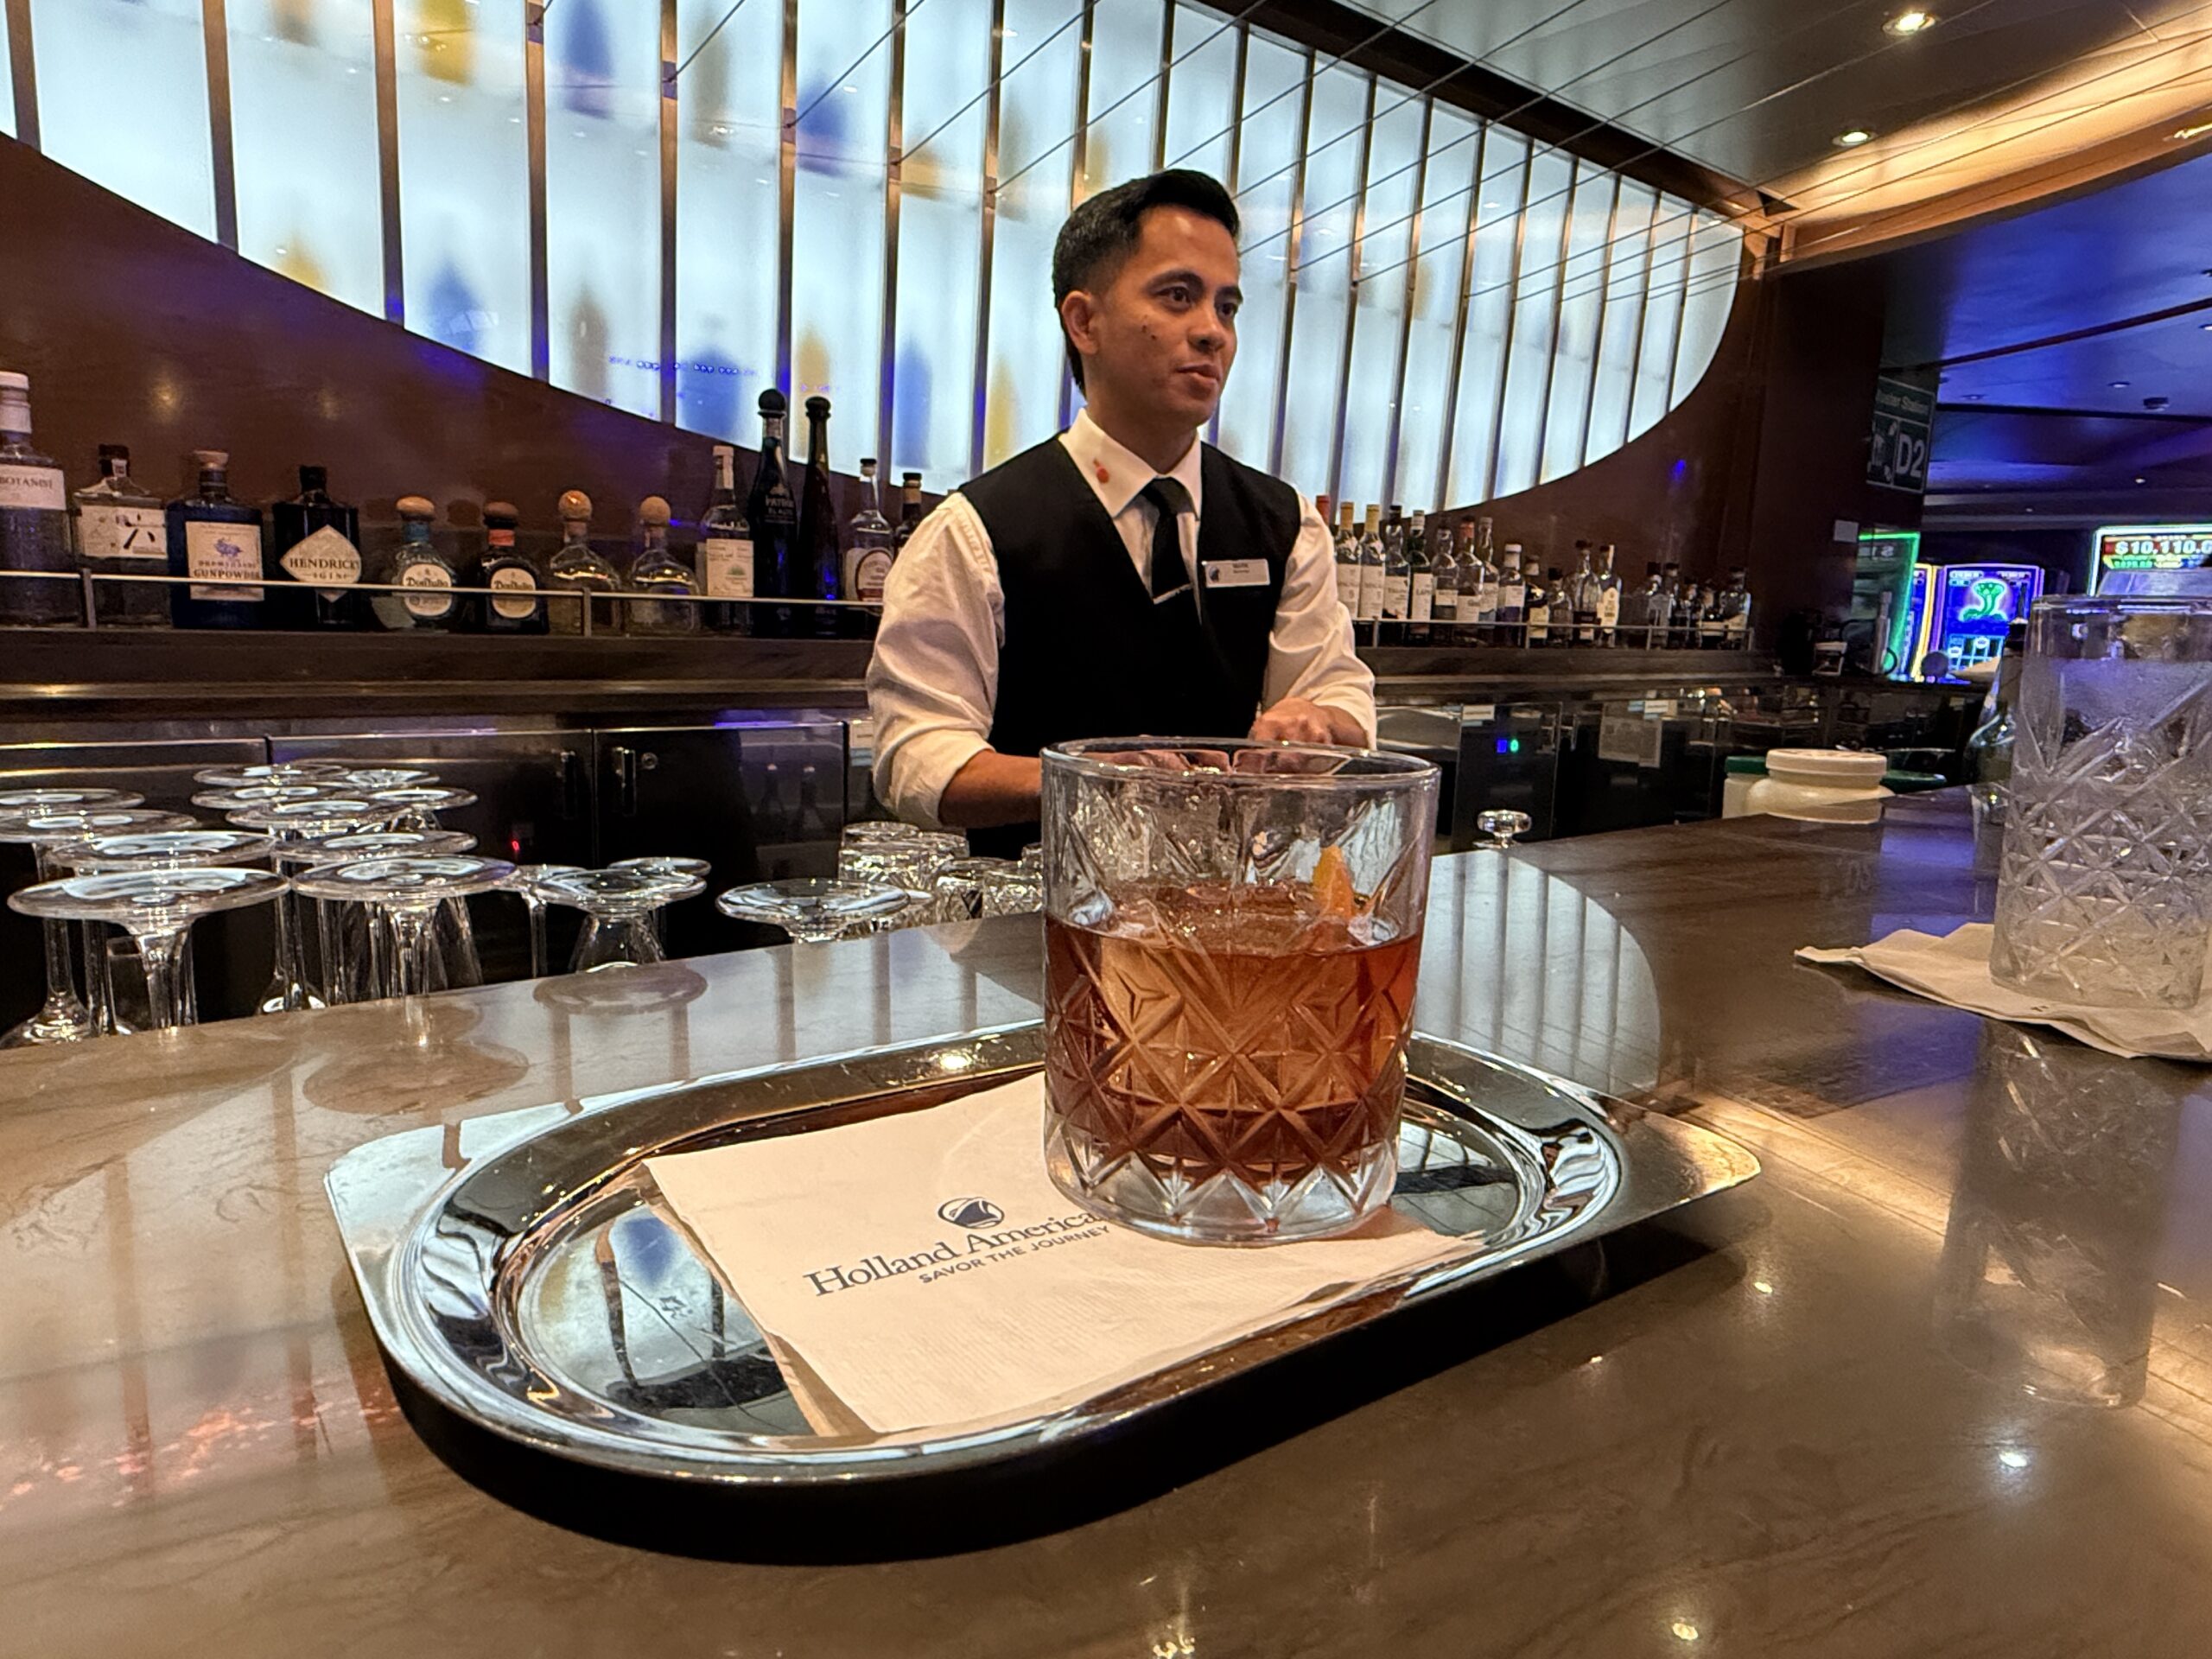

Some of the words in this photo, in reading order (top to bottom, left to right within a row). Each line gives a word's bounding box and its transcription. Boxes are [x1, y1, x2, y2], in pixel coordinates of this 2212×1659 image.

[1897, 433, 1925, 478] D2
[803, 1242, 963, 1296] Holland
[967, 1212, 1103, 1255] America
[918, 1258, 987, 1283] SAVOR
[985, 1246, 1027, 1262] THE
[1031, 1225, 1109, 1251] JOURNEY
